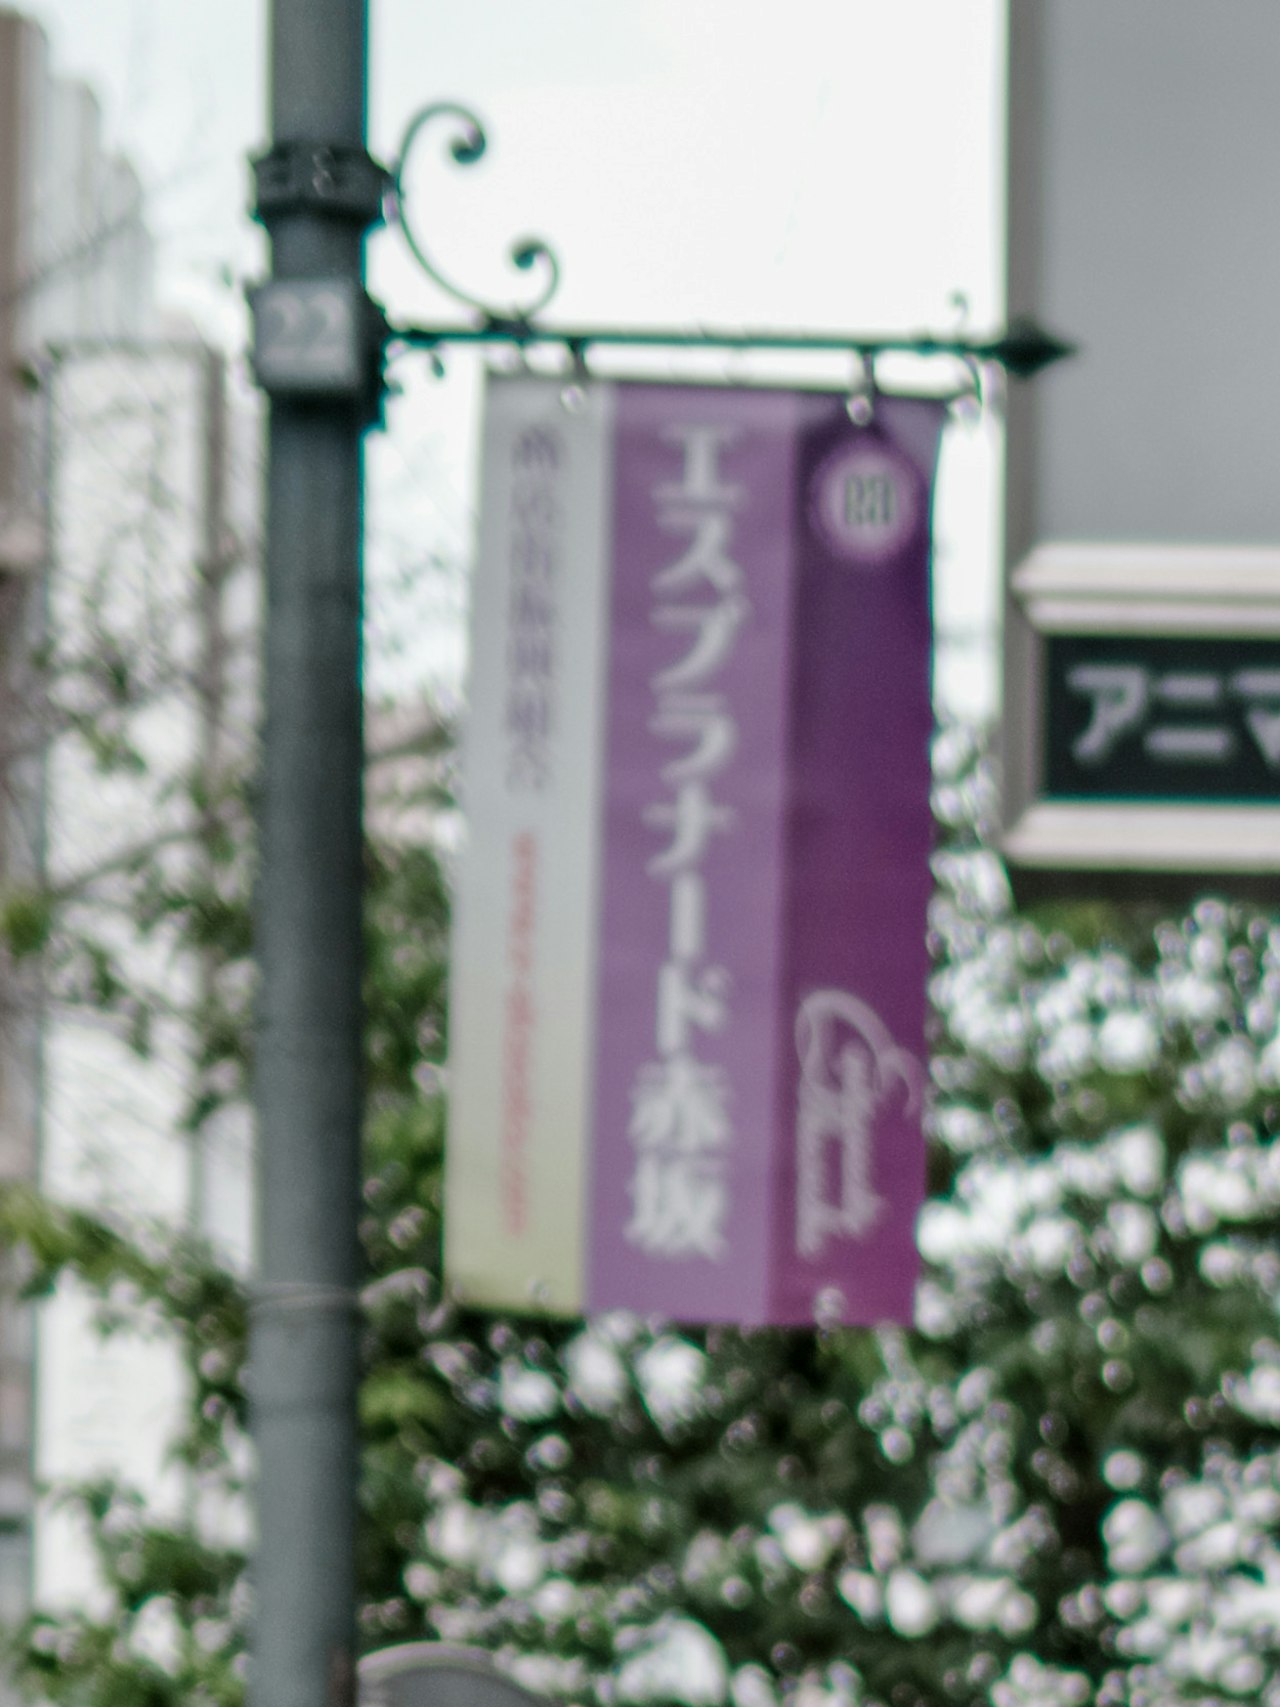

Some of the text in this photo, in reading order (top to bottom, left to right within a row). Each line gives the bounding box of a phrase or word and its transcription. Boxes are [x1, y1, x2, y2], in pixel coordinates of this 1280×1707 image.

[264, 292, 343, 360] 22
[623, 421, 750, 1262] エスプラナード赤坂
